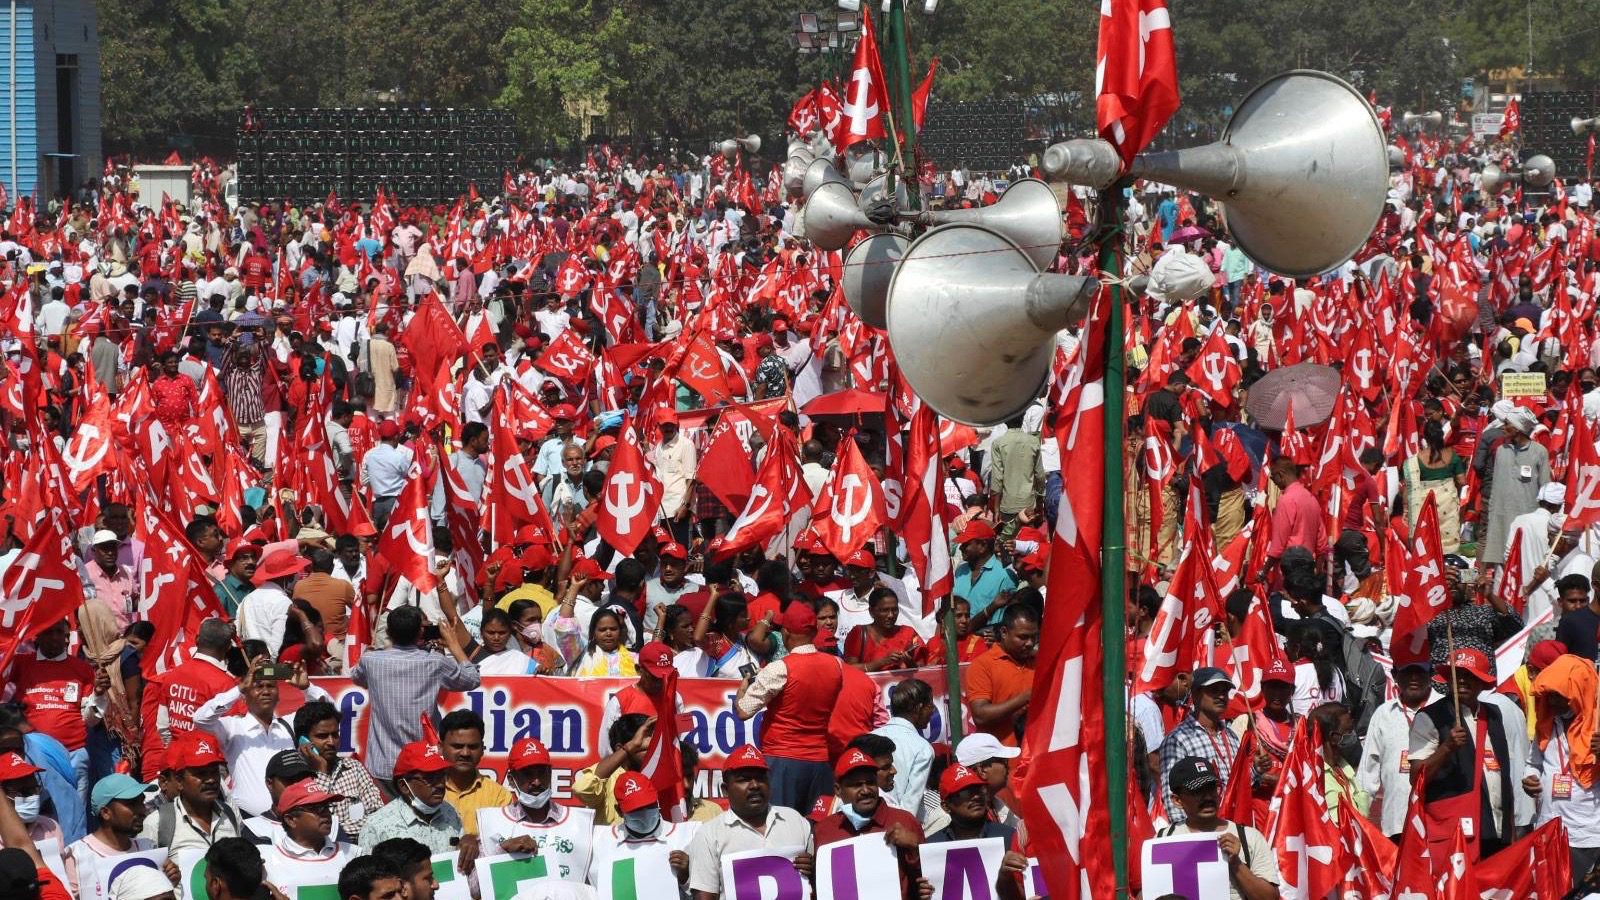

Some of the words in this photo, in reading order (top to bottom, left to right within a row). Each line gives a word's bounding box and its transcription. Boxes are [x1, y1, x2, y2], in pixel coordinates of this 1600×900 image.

[170, 683, 197, 702] CITU
[169, 701, 196, 718] AIKS
[340, 691, 365, 753] f
